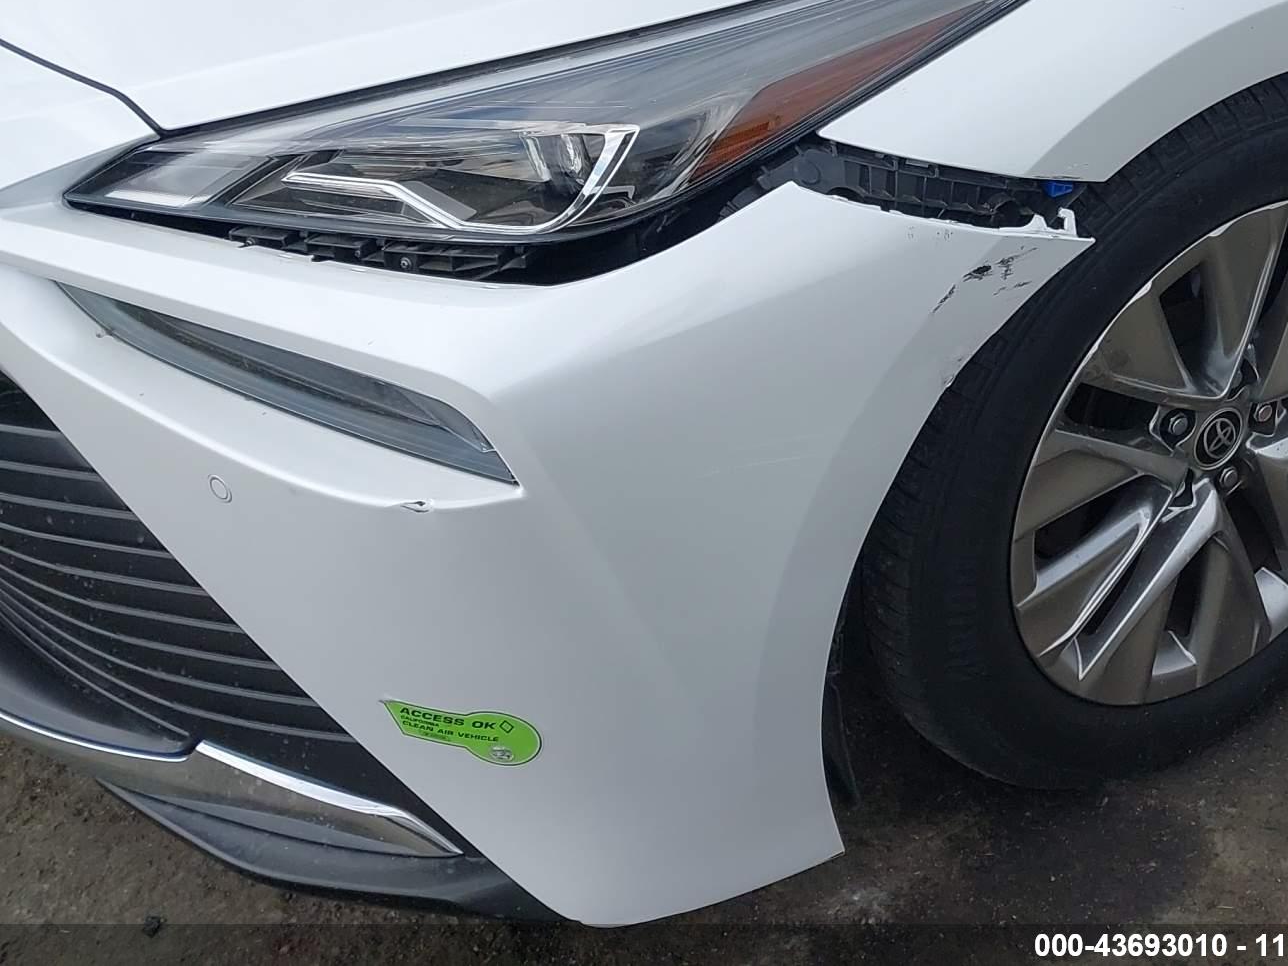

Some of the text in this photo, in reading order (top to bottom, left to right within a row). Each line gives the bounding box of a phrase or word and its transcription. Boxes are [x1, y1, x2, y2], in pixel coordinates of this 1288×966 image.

[400, 707, 496, 730] ACCESS OK
[402, 720, 434, 732] CLEAN
[458, 732, 499, 742] VEHICLE
